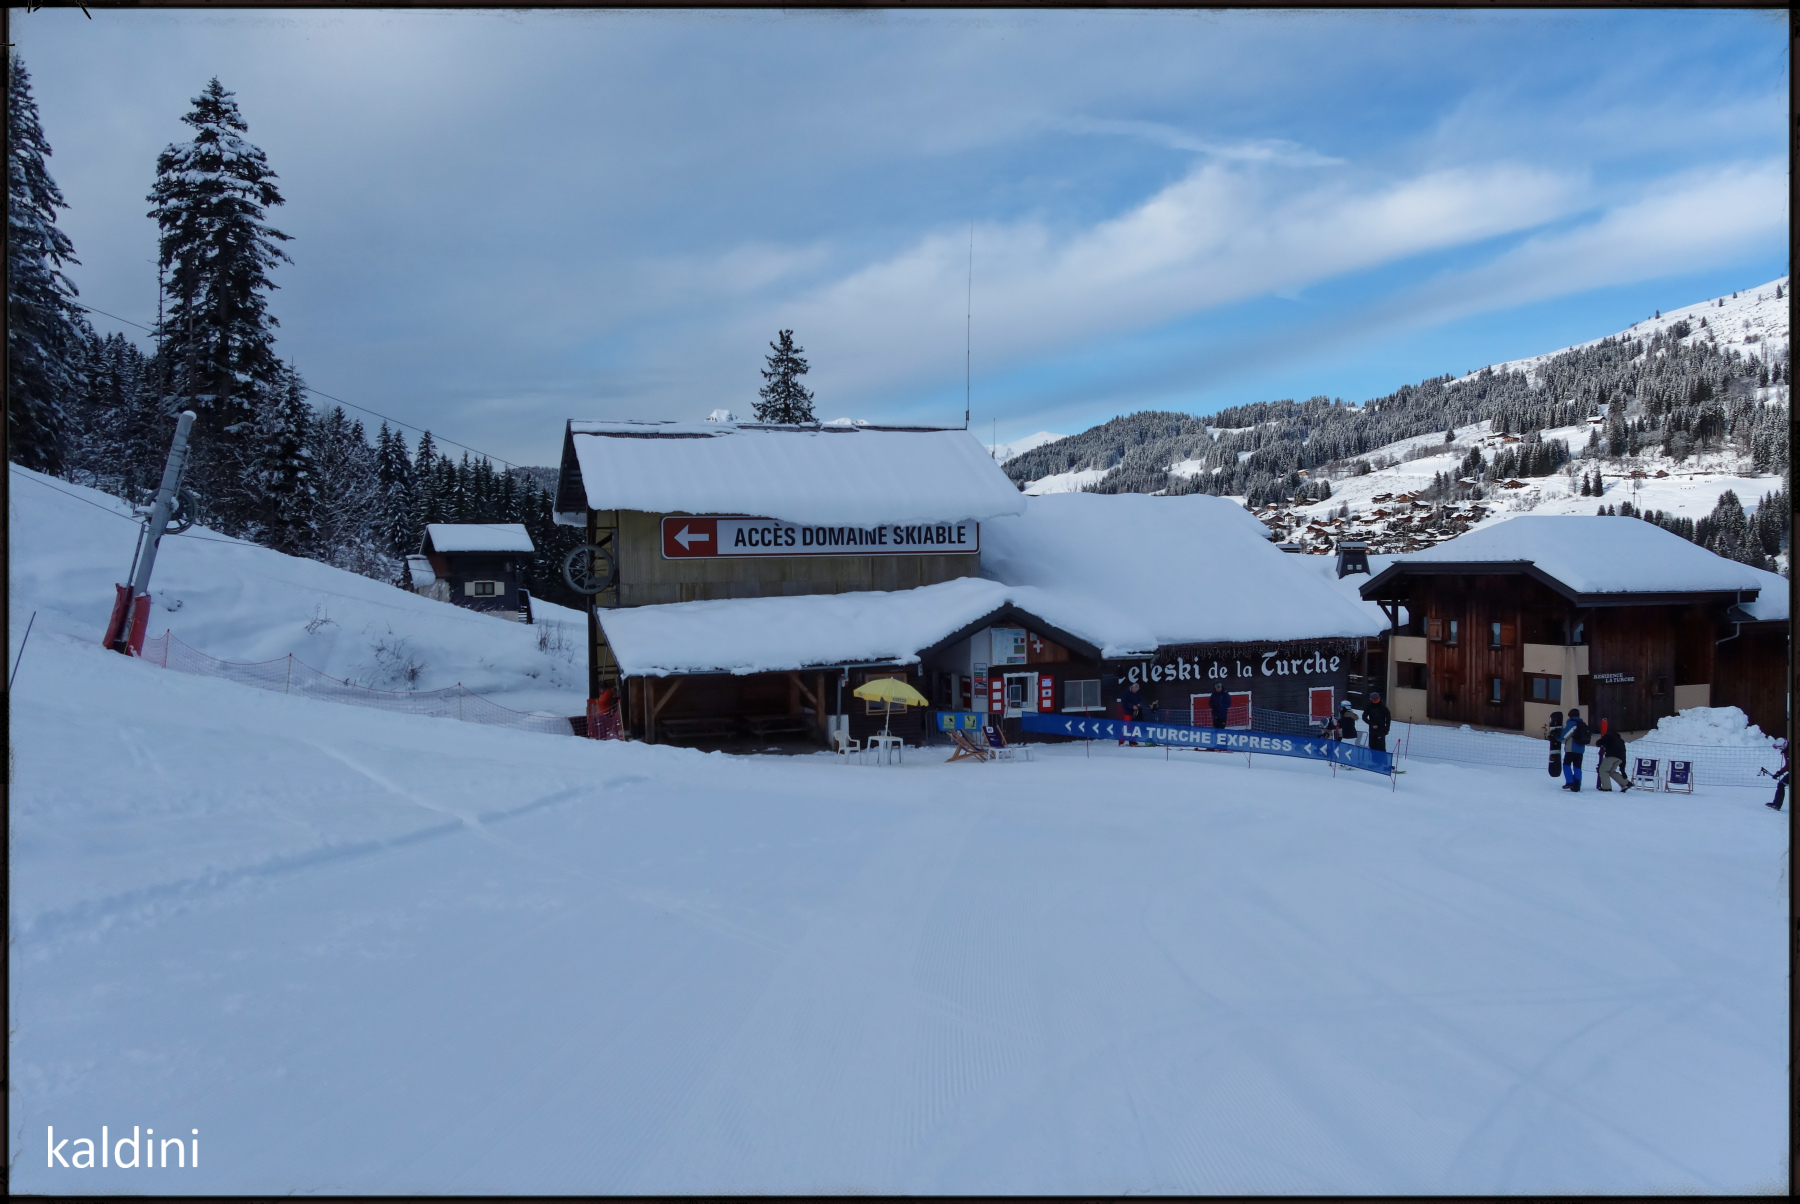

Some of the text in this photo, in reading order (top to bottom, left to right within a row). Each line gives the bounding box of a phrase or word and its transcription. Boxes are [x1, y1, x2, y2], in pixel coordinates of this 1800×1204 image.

[734, 523, 967, 547] ACCÈS DOMAINE SKIABLE
[1208, 661, 1228, 679] de
[1236, 661, 1252, 678] la
[1261, 651, 1340, 677] Turche
[1123, 725, 1293, 752] LA TURCHE EXPRESS
